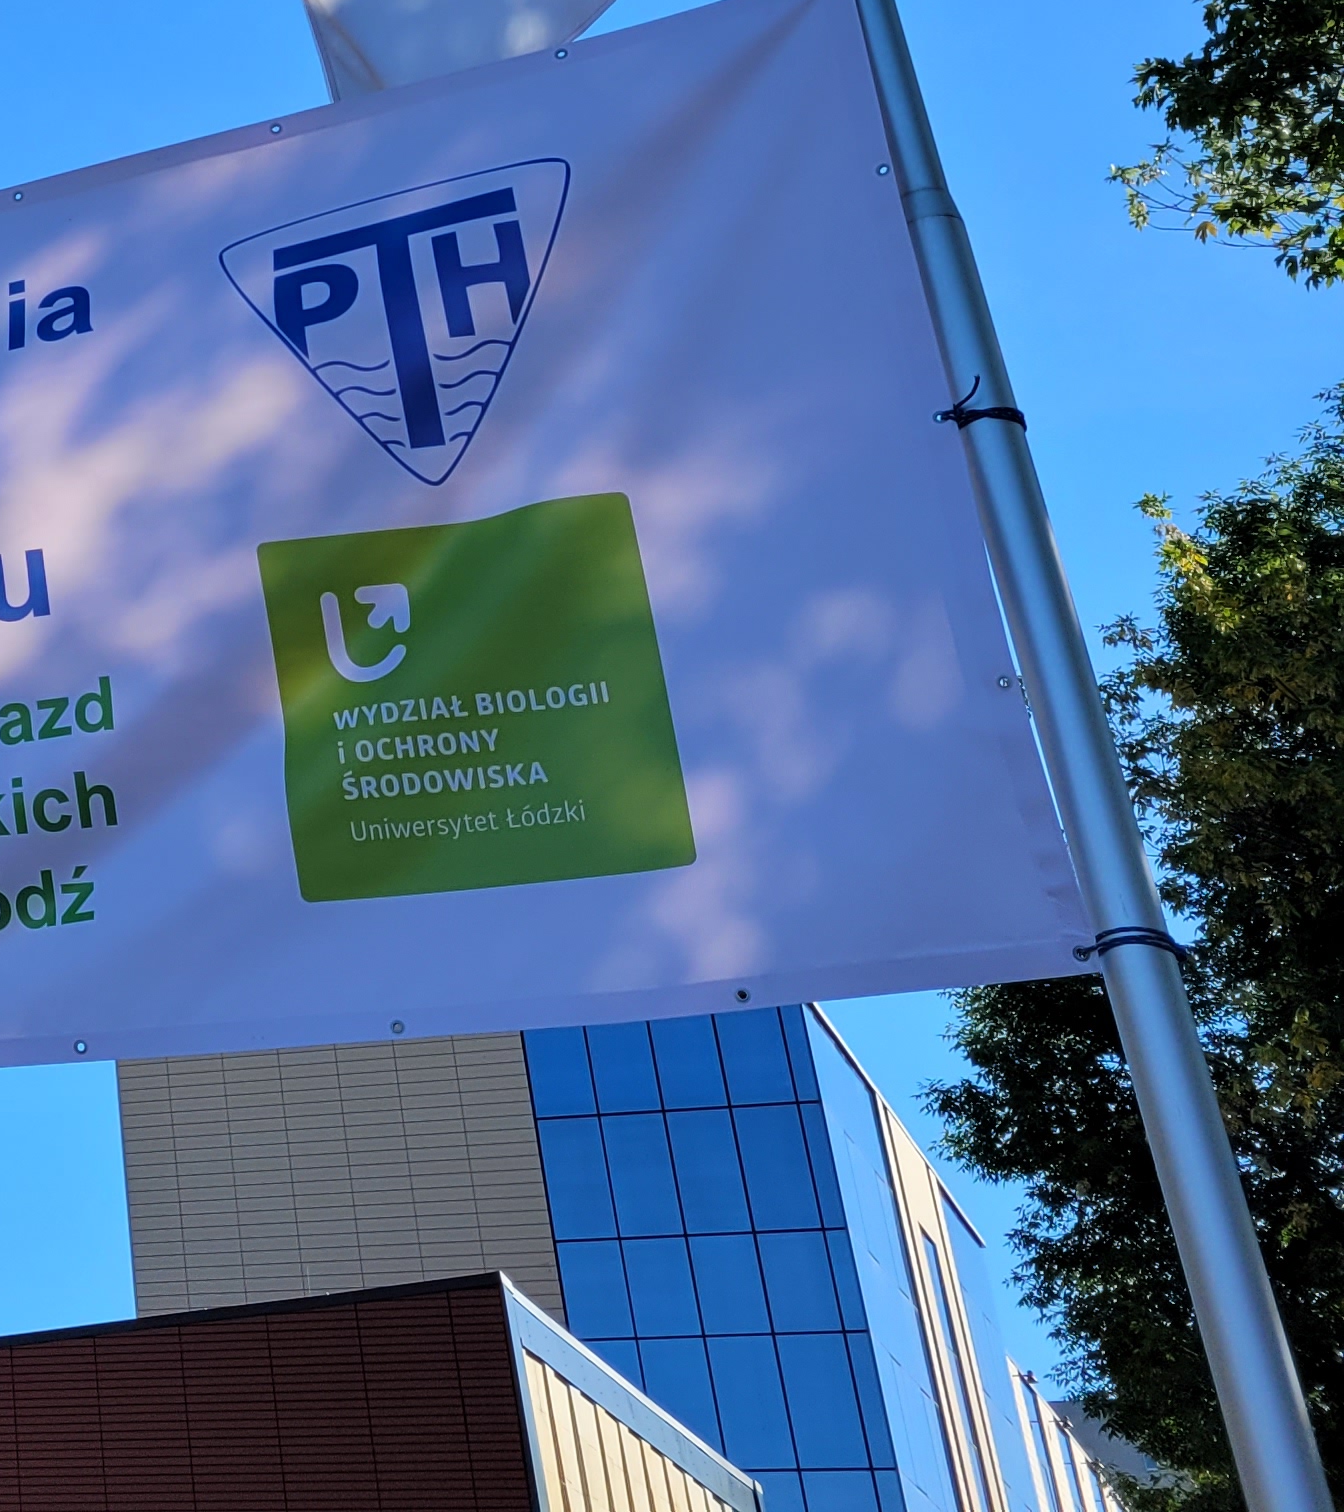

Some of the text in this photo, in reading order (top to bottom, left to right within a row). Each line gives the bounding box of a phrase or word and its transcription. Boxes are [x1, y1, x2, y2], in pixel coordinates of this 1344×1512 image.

[273, 187, 531, 449] PTH
[333, 680, 611, 731] WYDZIAŁ BIOLOGII
[337, 728, 499, 765] i OCHRONY
[342, 761, 549, 801] ŚRODOWISKA
[350, 799, 587, 842] Uniwersytet Łódzki
